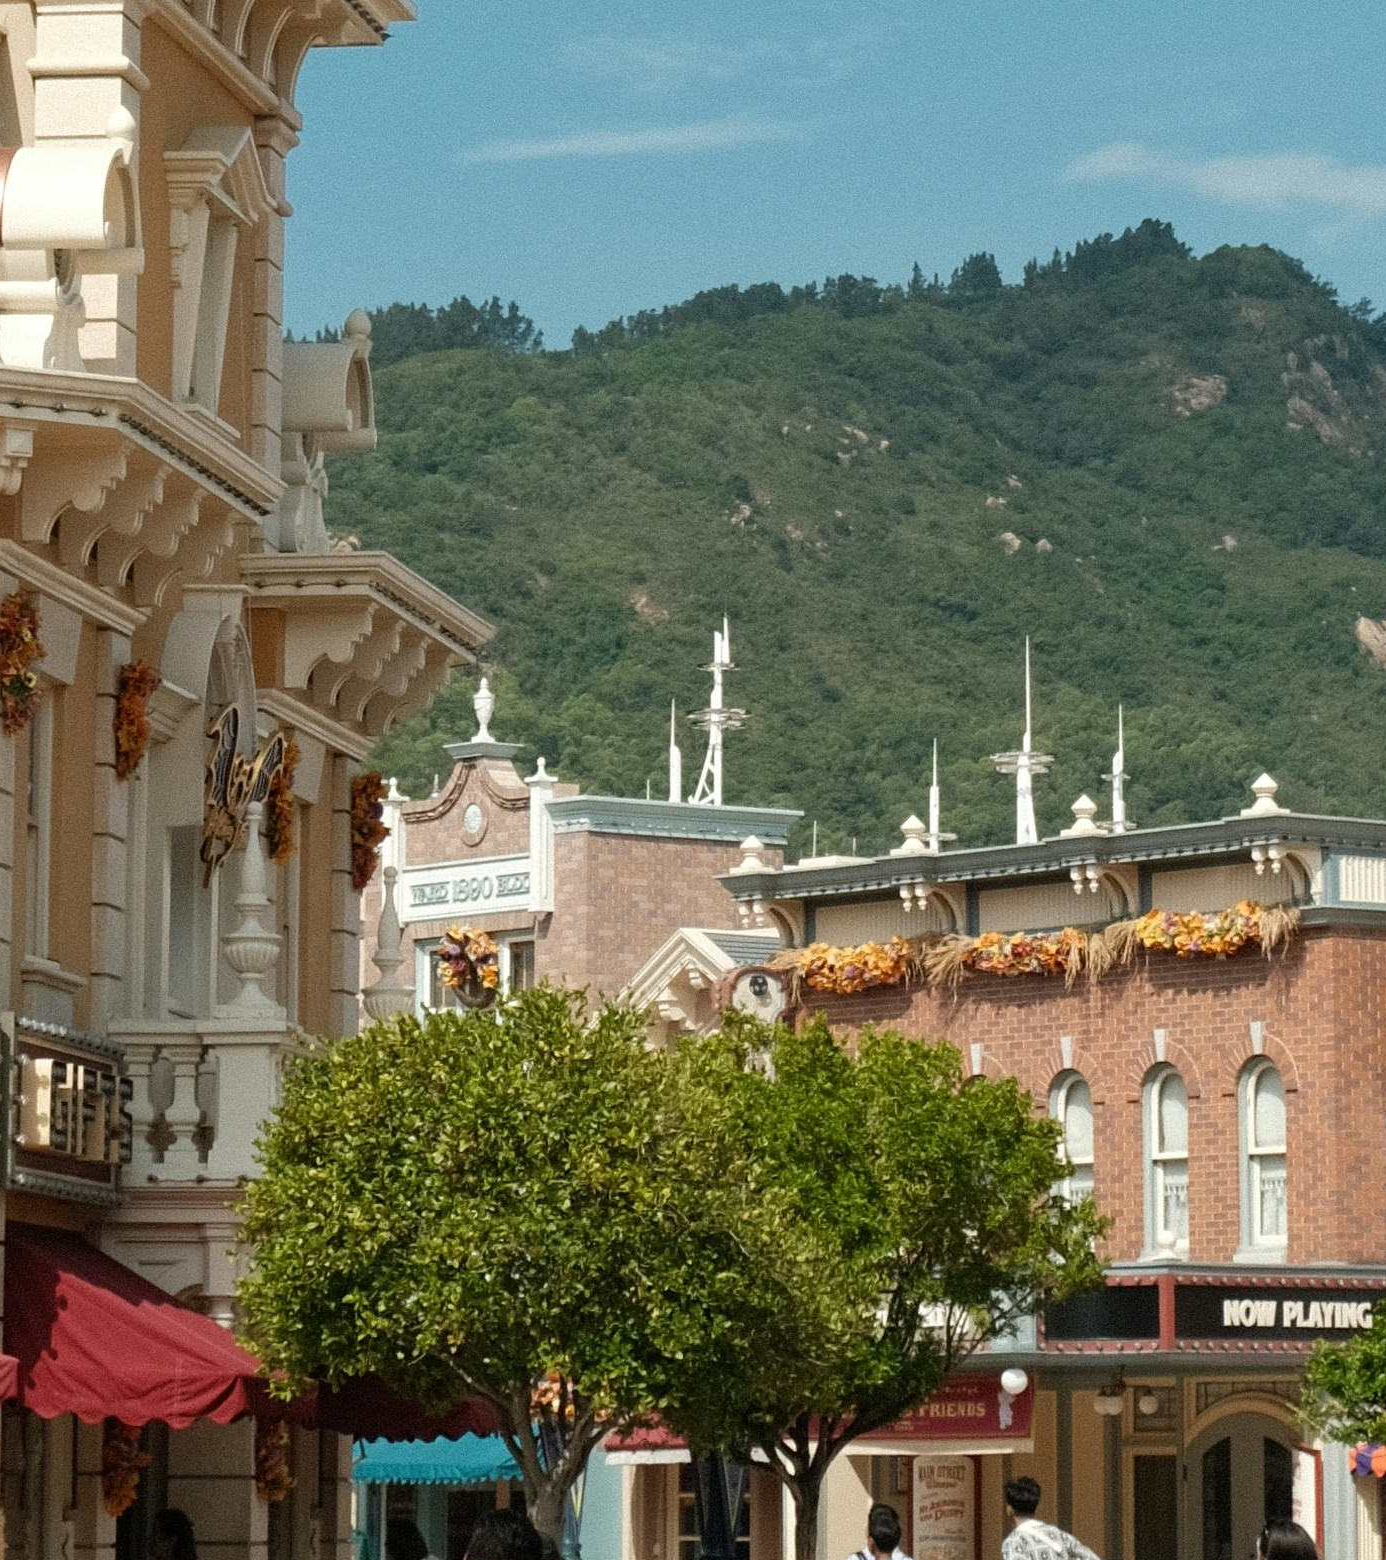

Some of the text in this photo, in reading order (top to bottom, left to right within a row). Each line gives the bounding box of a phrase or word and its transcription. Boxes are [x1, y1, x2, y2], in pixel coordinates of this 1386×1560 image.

[452, 876, 493, 903] 1890
[1224, 1299, 1373, 1329] NOW PLAYING
[919, 1401, 987, 1418] FRIENDS
